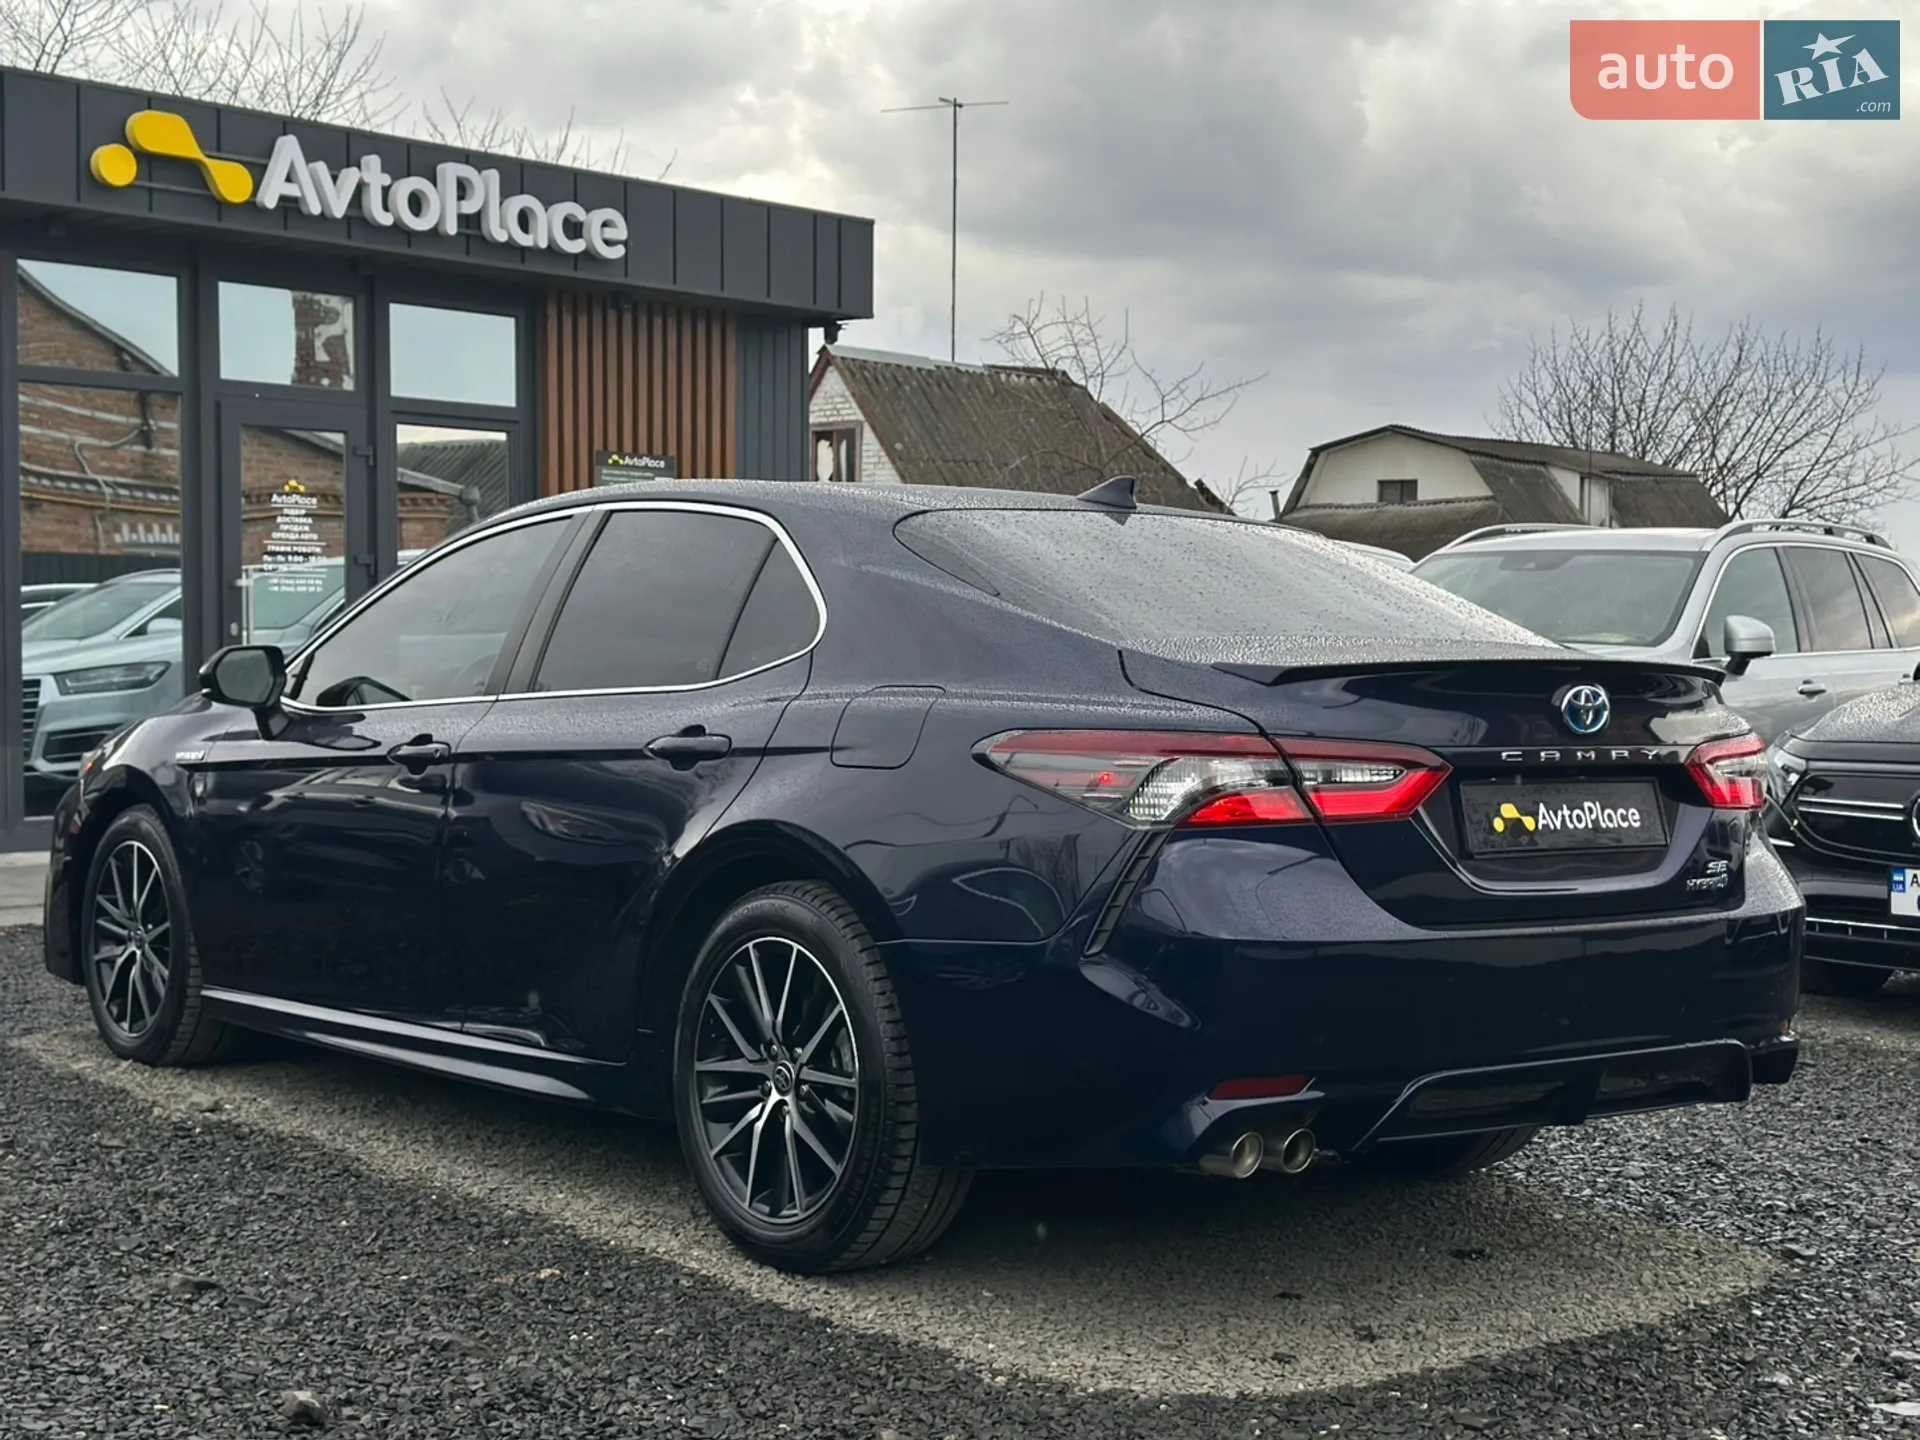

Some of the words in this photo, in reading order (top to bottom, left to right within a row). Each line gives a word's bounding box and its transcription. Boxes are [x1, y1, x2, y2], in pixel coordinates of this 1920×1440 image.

[256, 134, 629, 259] AvtoPlace
[624, 455, 666, 469] AvtoPlace
[271, 493, 318, 505] AvtoPlace
[1501, 749, 1660, 762] CAMRY
[1537, 800, 1641, 831] AvtoPlace
[1706, 859, 1729, 874] SE
[1892, 882, 1905, 891] UA
